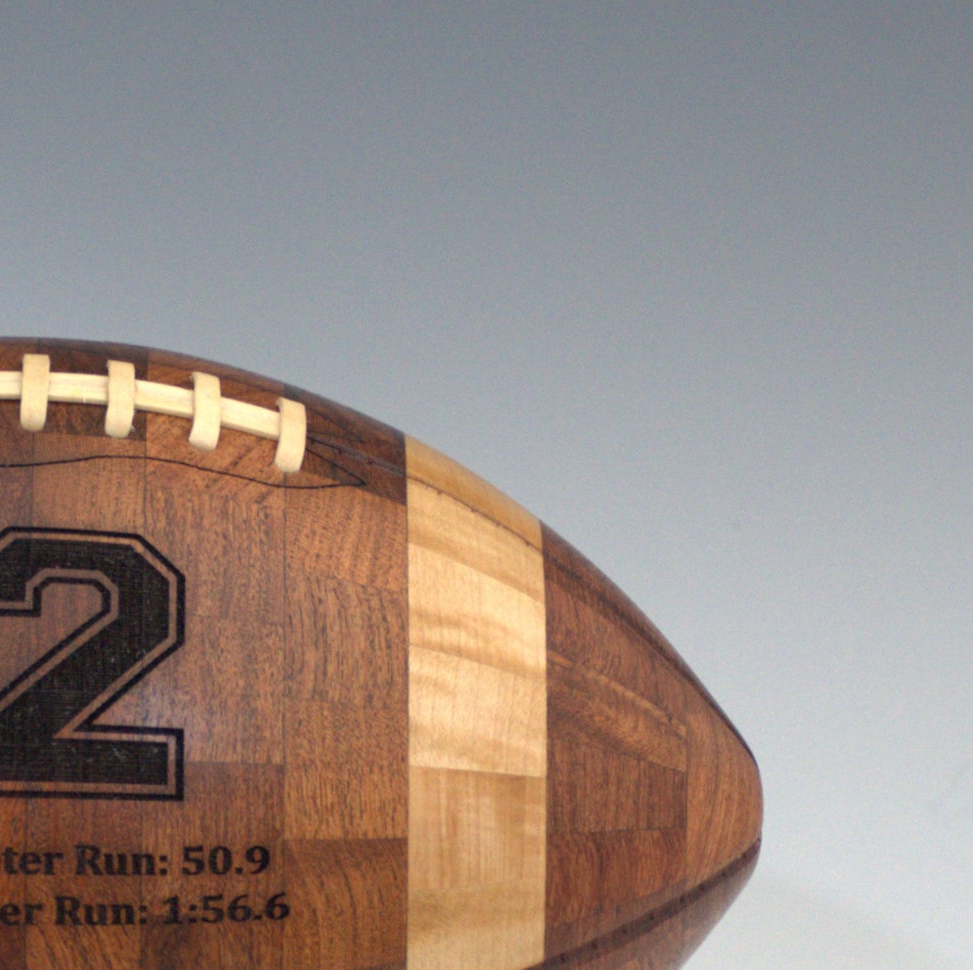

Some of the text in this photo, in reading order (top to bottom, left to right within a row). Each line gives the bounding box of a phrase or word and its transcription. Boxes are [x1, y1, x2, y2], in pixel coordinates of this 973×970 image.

[74, 845, 168, 876] Run:
[182, 845, 270, 876] 50.9
[54, 895, 148, 926] Run:
[162, 893, 290, 924] 1:56.6
